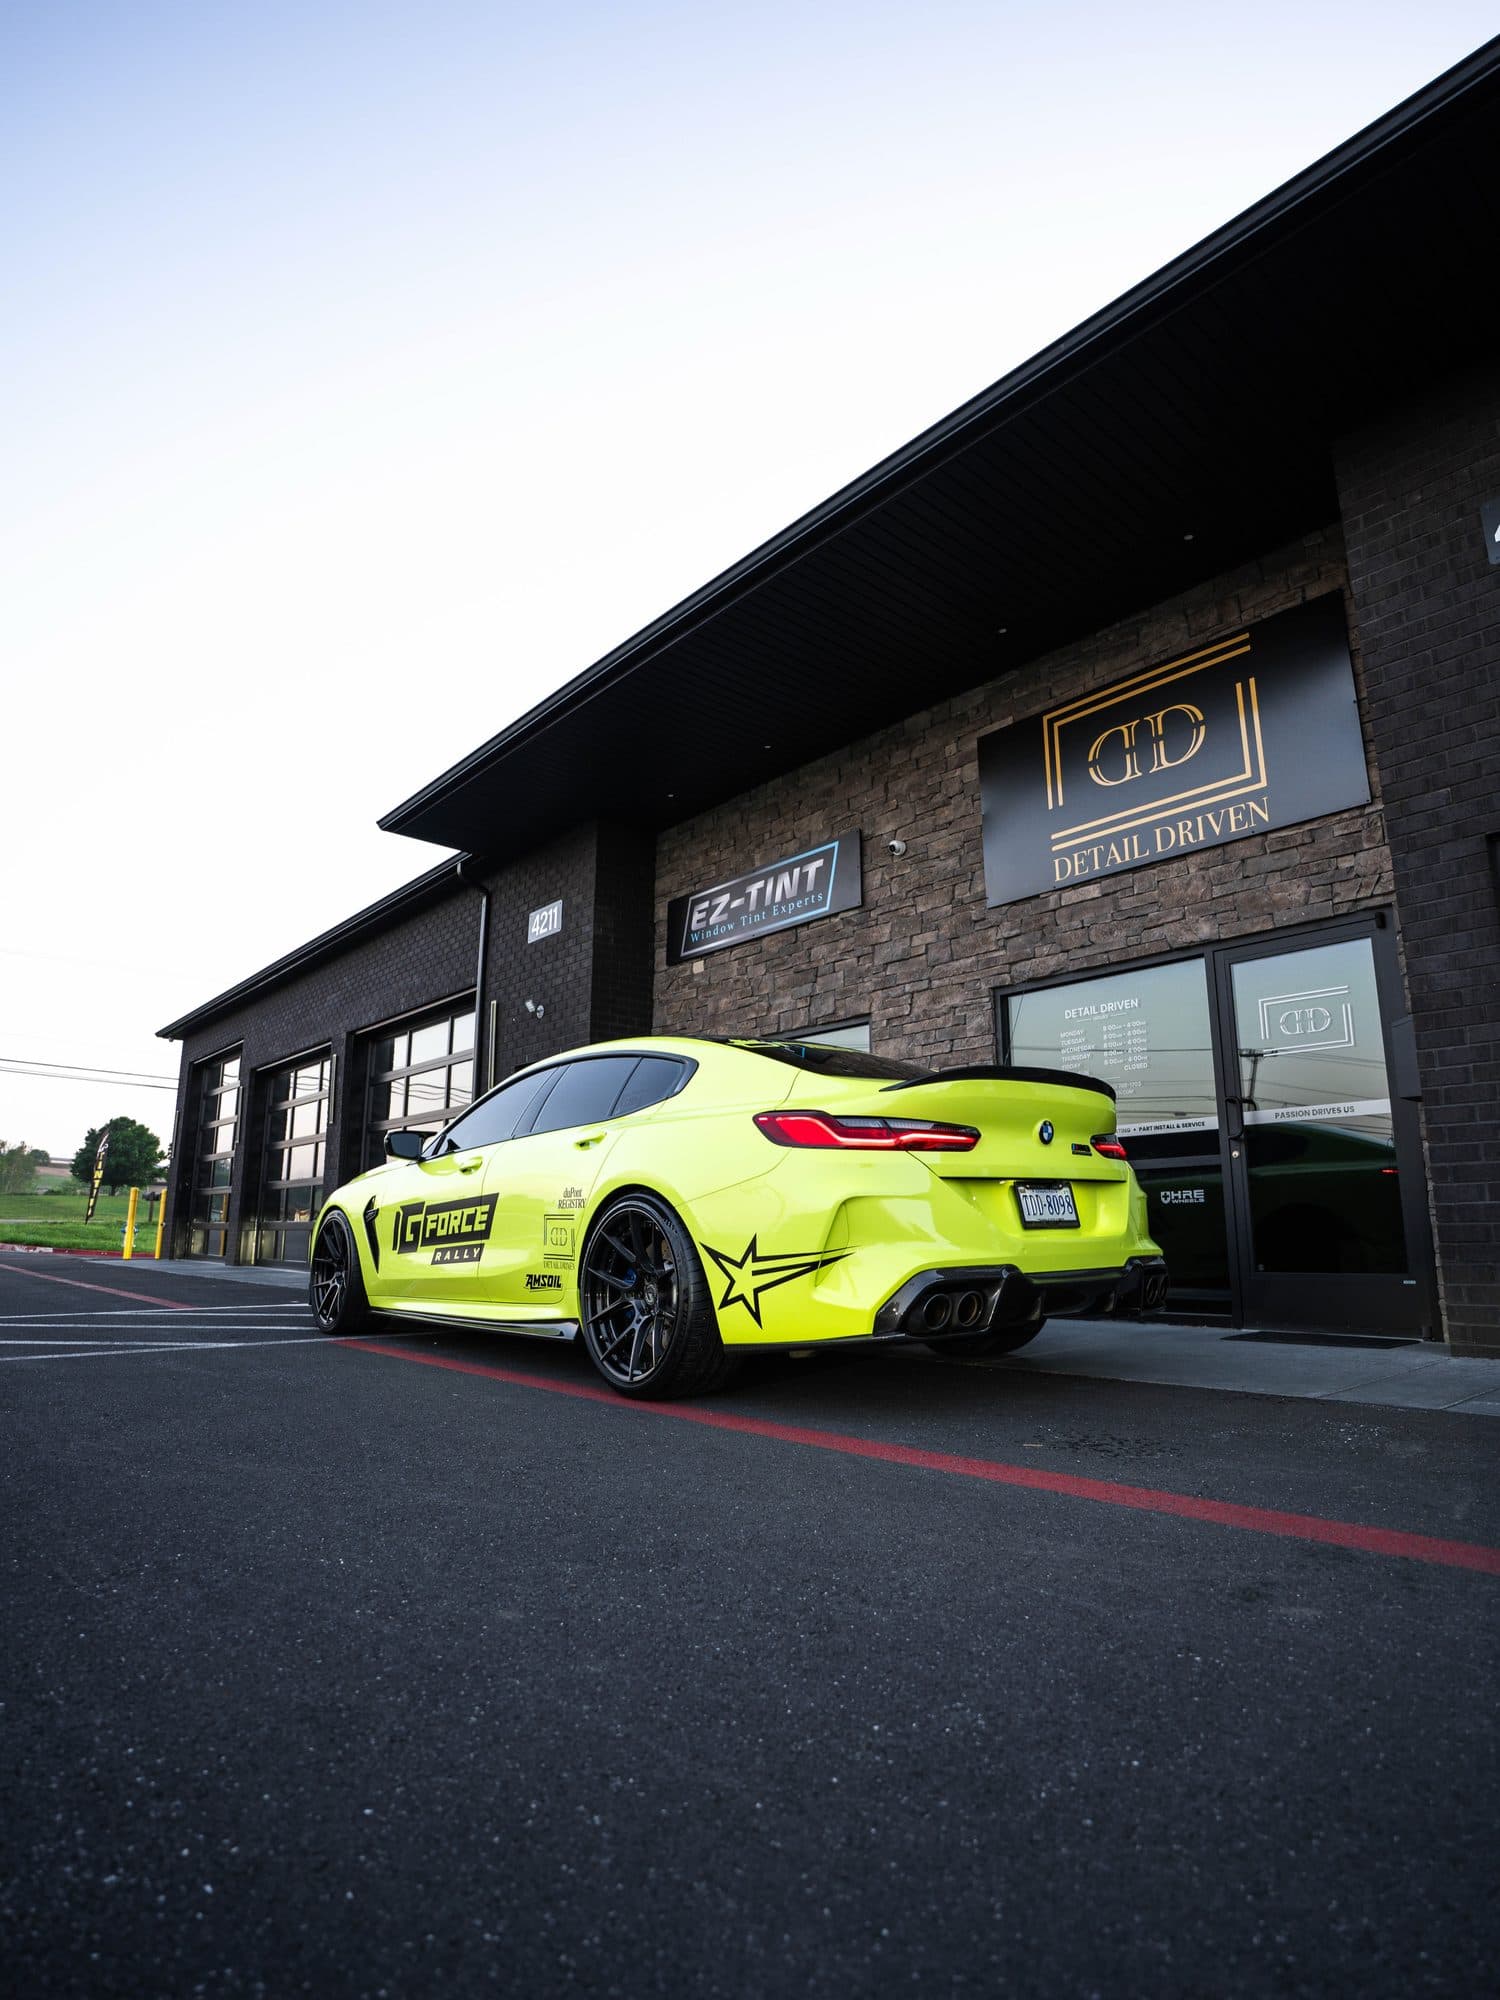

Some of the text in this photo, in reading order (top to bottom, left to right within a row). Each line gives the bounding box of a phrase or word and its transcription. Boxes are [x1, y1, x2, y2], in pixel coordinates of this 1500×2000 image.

[1053, 797, 1271, 883] DETAIL DRIVEN
[691, 858, 824, 931] EZ-TINT
[531, 906, 558, 937] 4211
[689, 892, 824, 944] Window Tint Experts
[1064, 1005, 1098, 1019] DETAIL
[1100, 998, 1139, 1013] DRIVEN
[1274, 1105, 1355, 1119] PASSION DRIVES US
[1138, 1125, 1153, 1133] PART
[1181, 1121, 1205, 1129] SERVICE
[1171, 1189, 1204, 1199] HRE
[558, 1199, 586, 1209] REGISTRY
[434, 1247, 480, 1262] RALLY
[525, 1273, 562, 1289] AMSOIL
